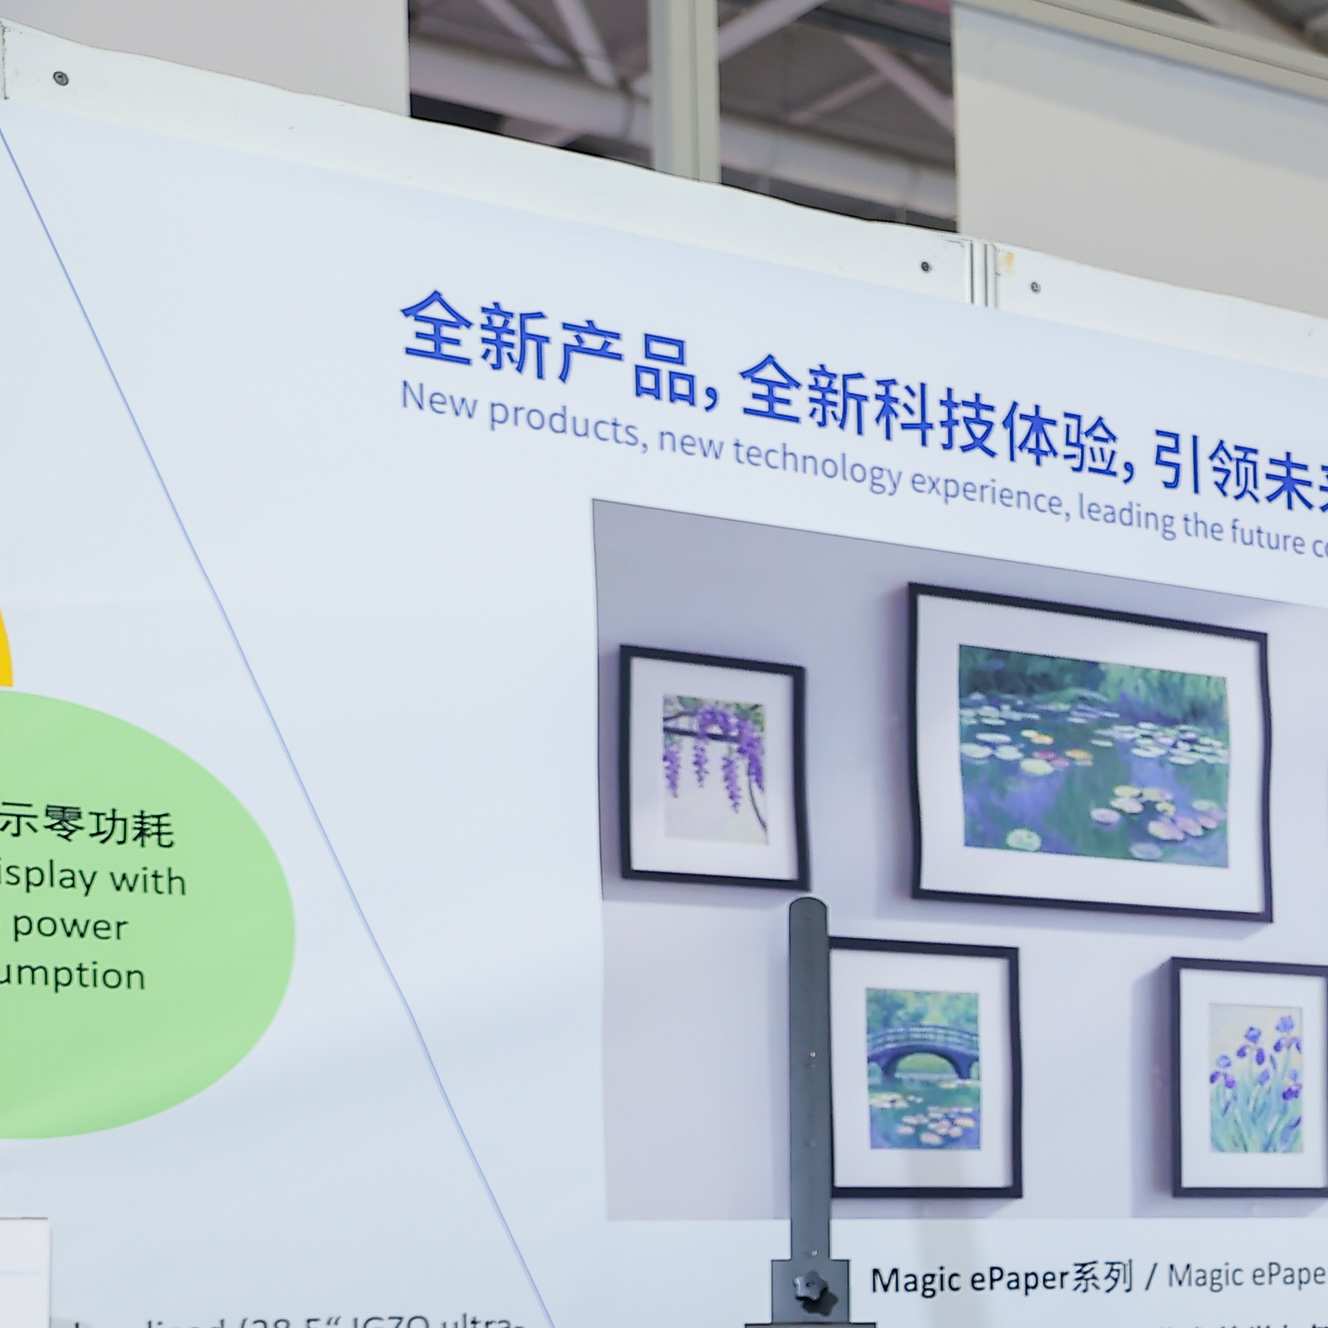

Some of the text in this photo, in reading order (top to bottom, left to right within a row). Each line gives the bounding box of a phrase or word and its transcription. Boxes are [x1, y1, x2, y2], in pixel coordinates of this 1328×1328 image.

[401, 380, 477, 419] New
[489, 396, 649, 453] products,
[659, 429, 724, 460] new
[733, 437, 902, 495] technology
[911, 471, 1071, 521] experience,
[1079, 493, 1175, 540] leading
[1183, 513, 1223, 542] the
[1231, 519, 1304, 555] future
[0, 802, 174, 848] 示零功耗
[110, 867, 186, 895] with
[13, 914, 128, 942] power
[872, 1265, 961, 1299] Magic
[1168, 1262, 1244, 1293] Magic
